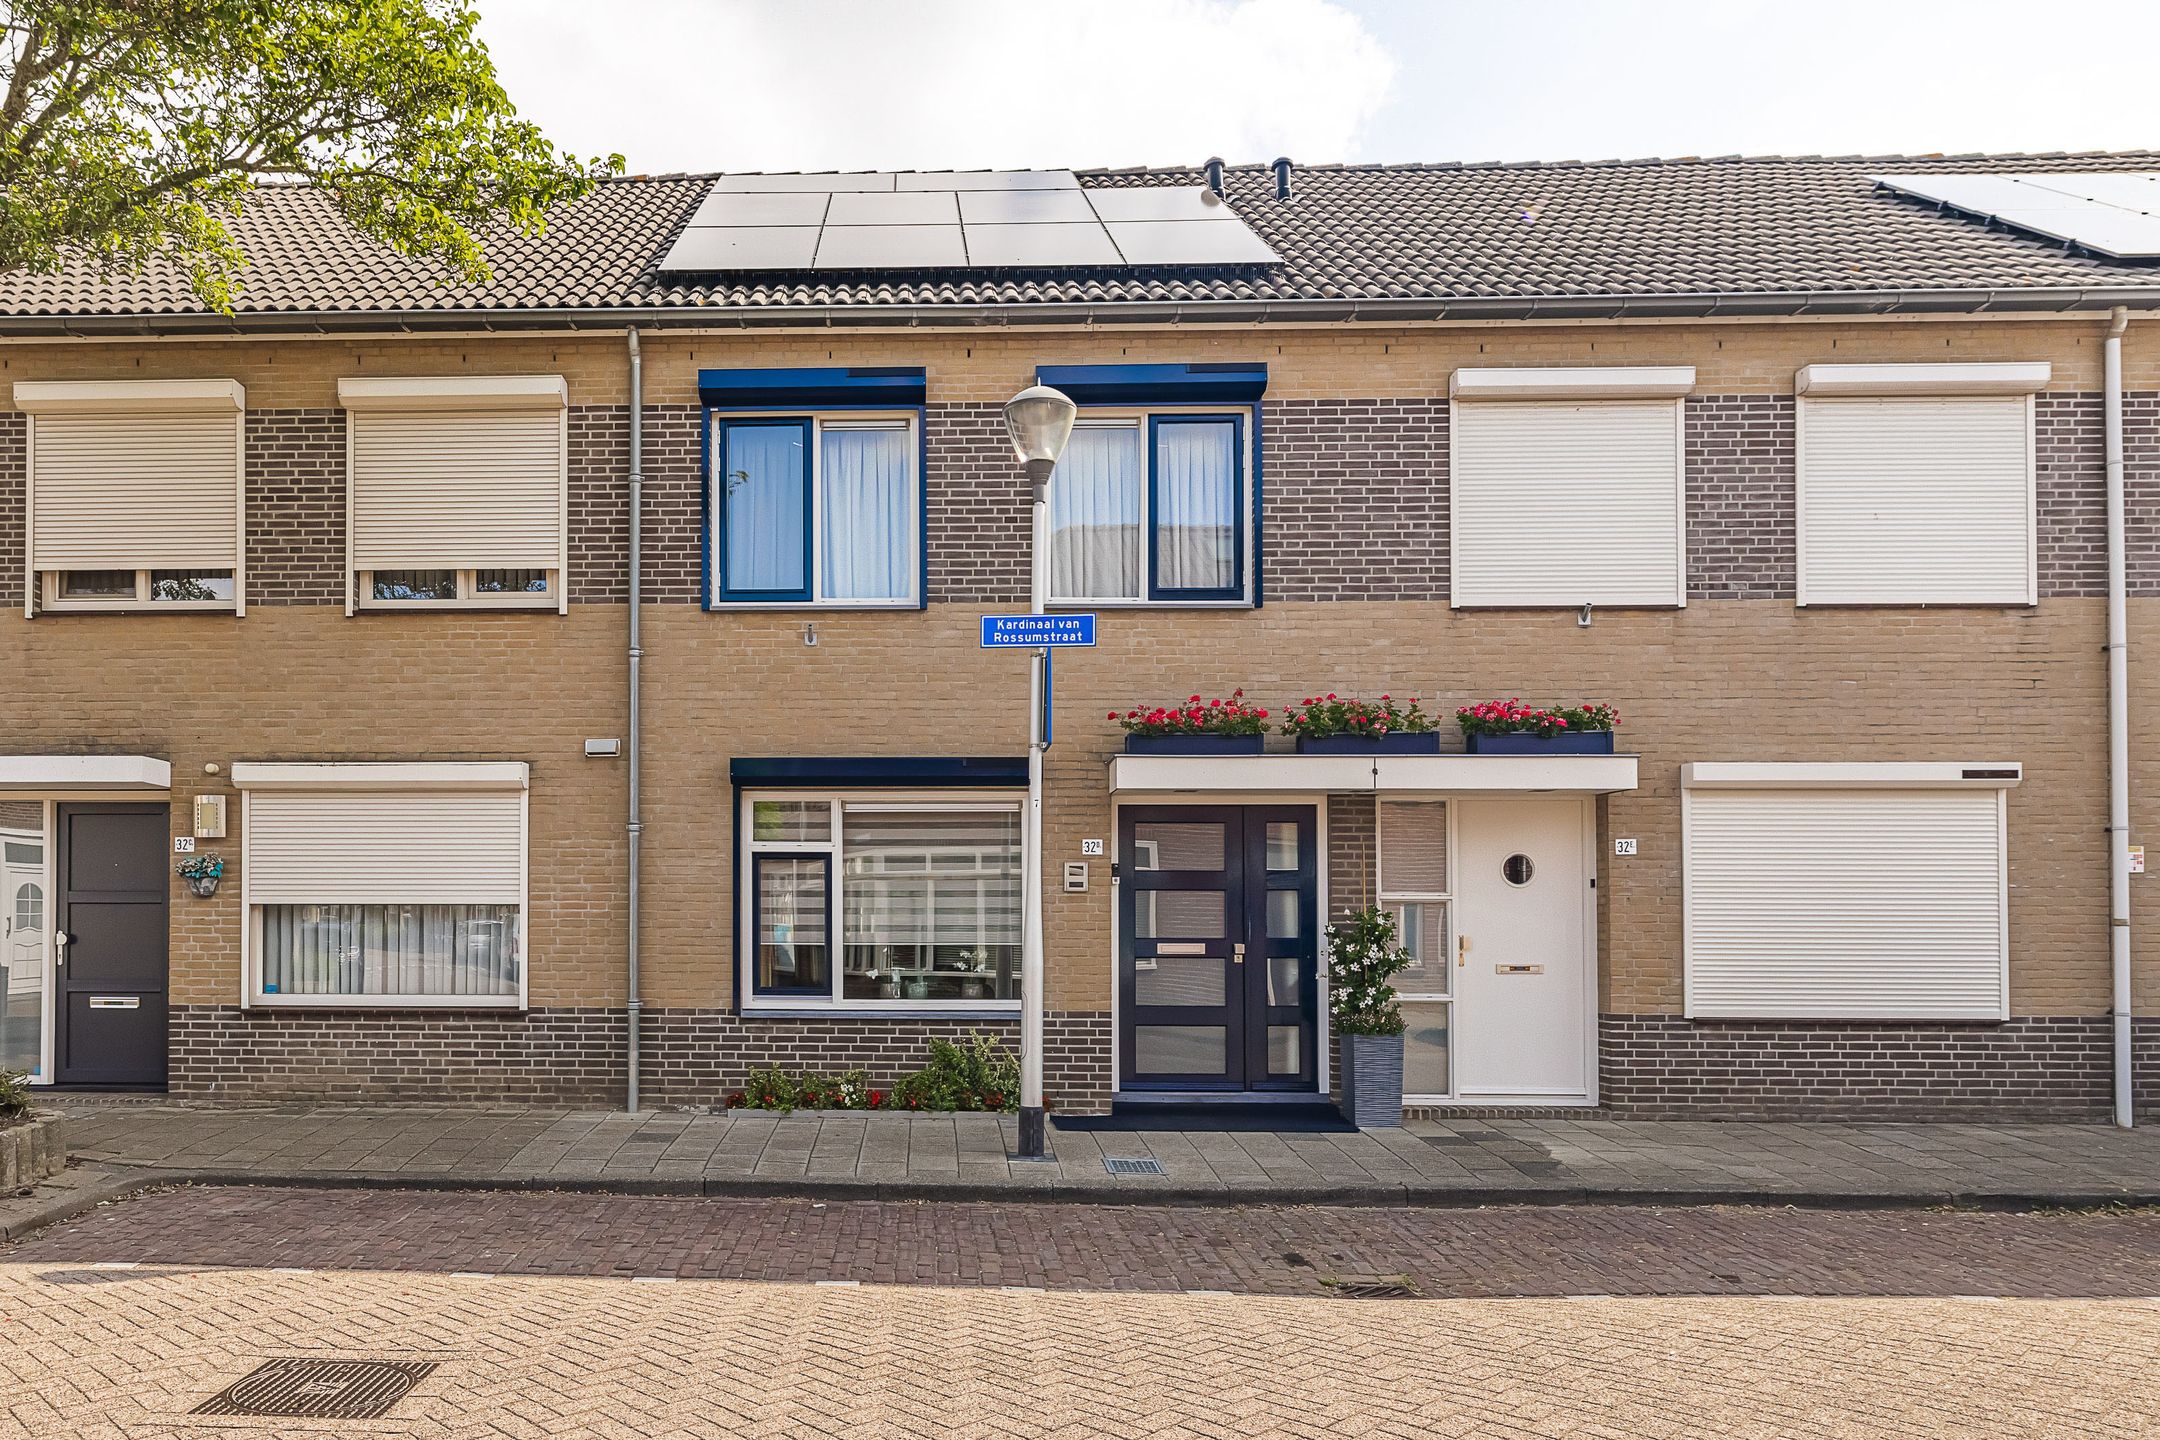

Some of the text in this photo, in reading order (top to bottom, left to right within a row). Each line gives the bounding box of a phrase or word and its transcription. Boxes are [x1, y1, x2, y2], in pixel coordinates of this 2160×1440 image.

[997, 619, 1080, 630] Kardinaal van
[993, 631, 1083, 643] Rossumstraat
